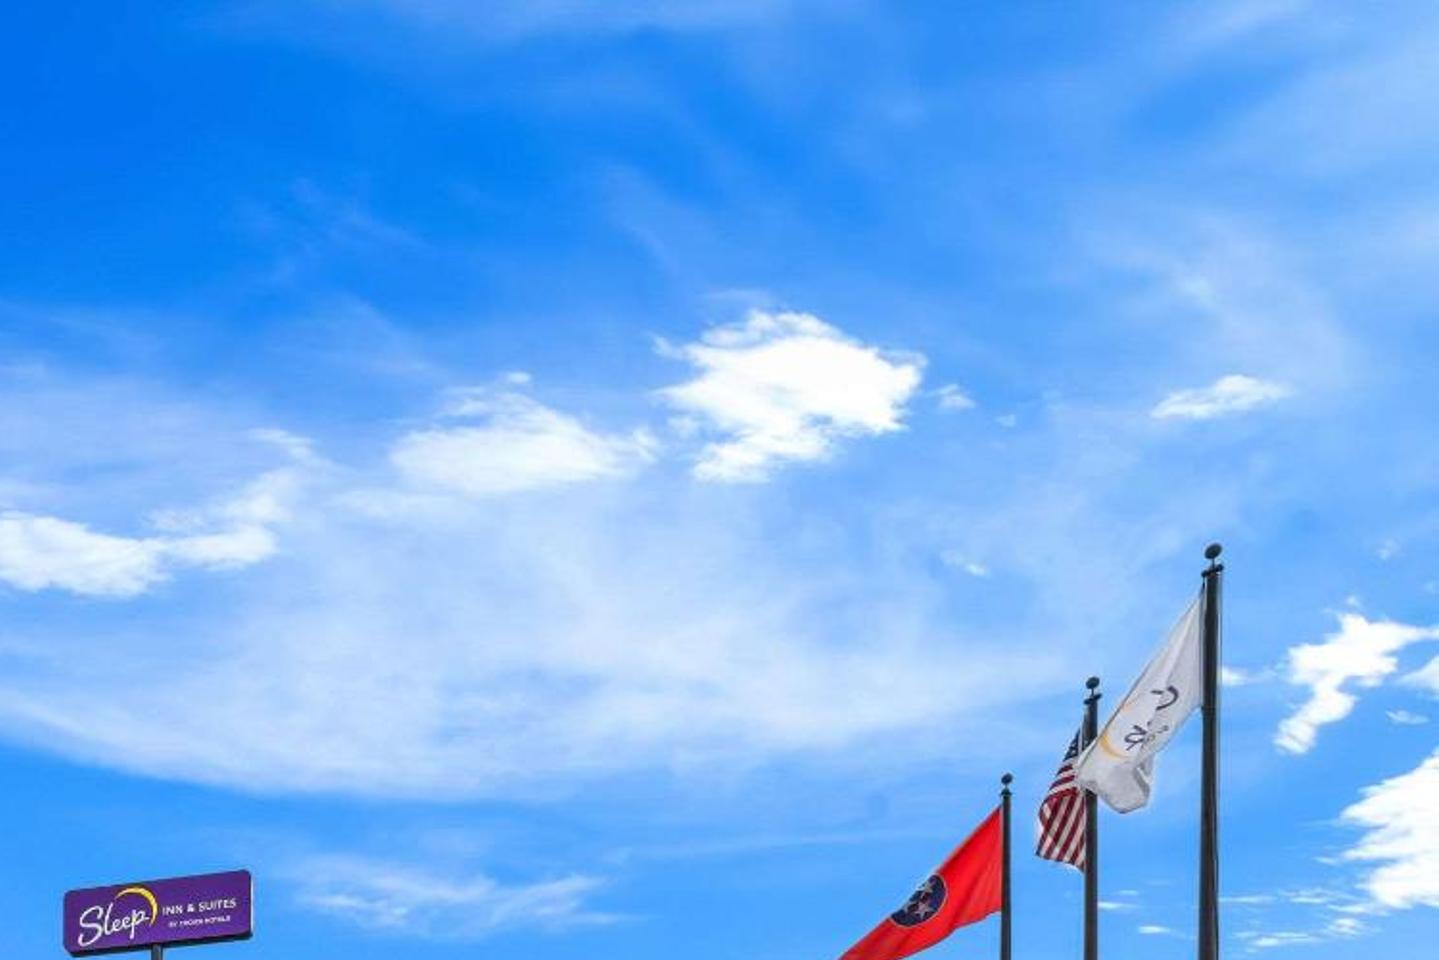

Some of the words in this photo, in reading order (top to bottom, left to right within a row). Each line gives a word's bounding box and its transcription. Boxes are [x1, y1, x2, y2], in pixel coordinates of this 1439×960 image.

[162, 905, 183, 916] INN
[187, 904, 194, 912] &
[198, 898, 237, 912] SUITES
[78, 902, 149, 947] Sleep
